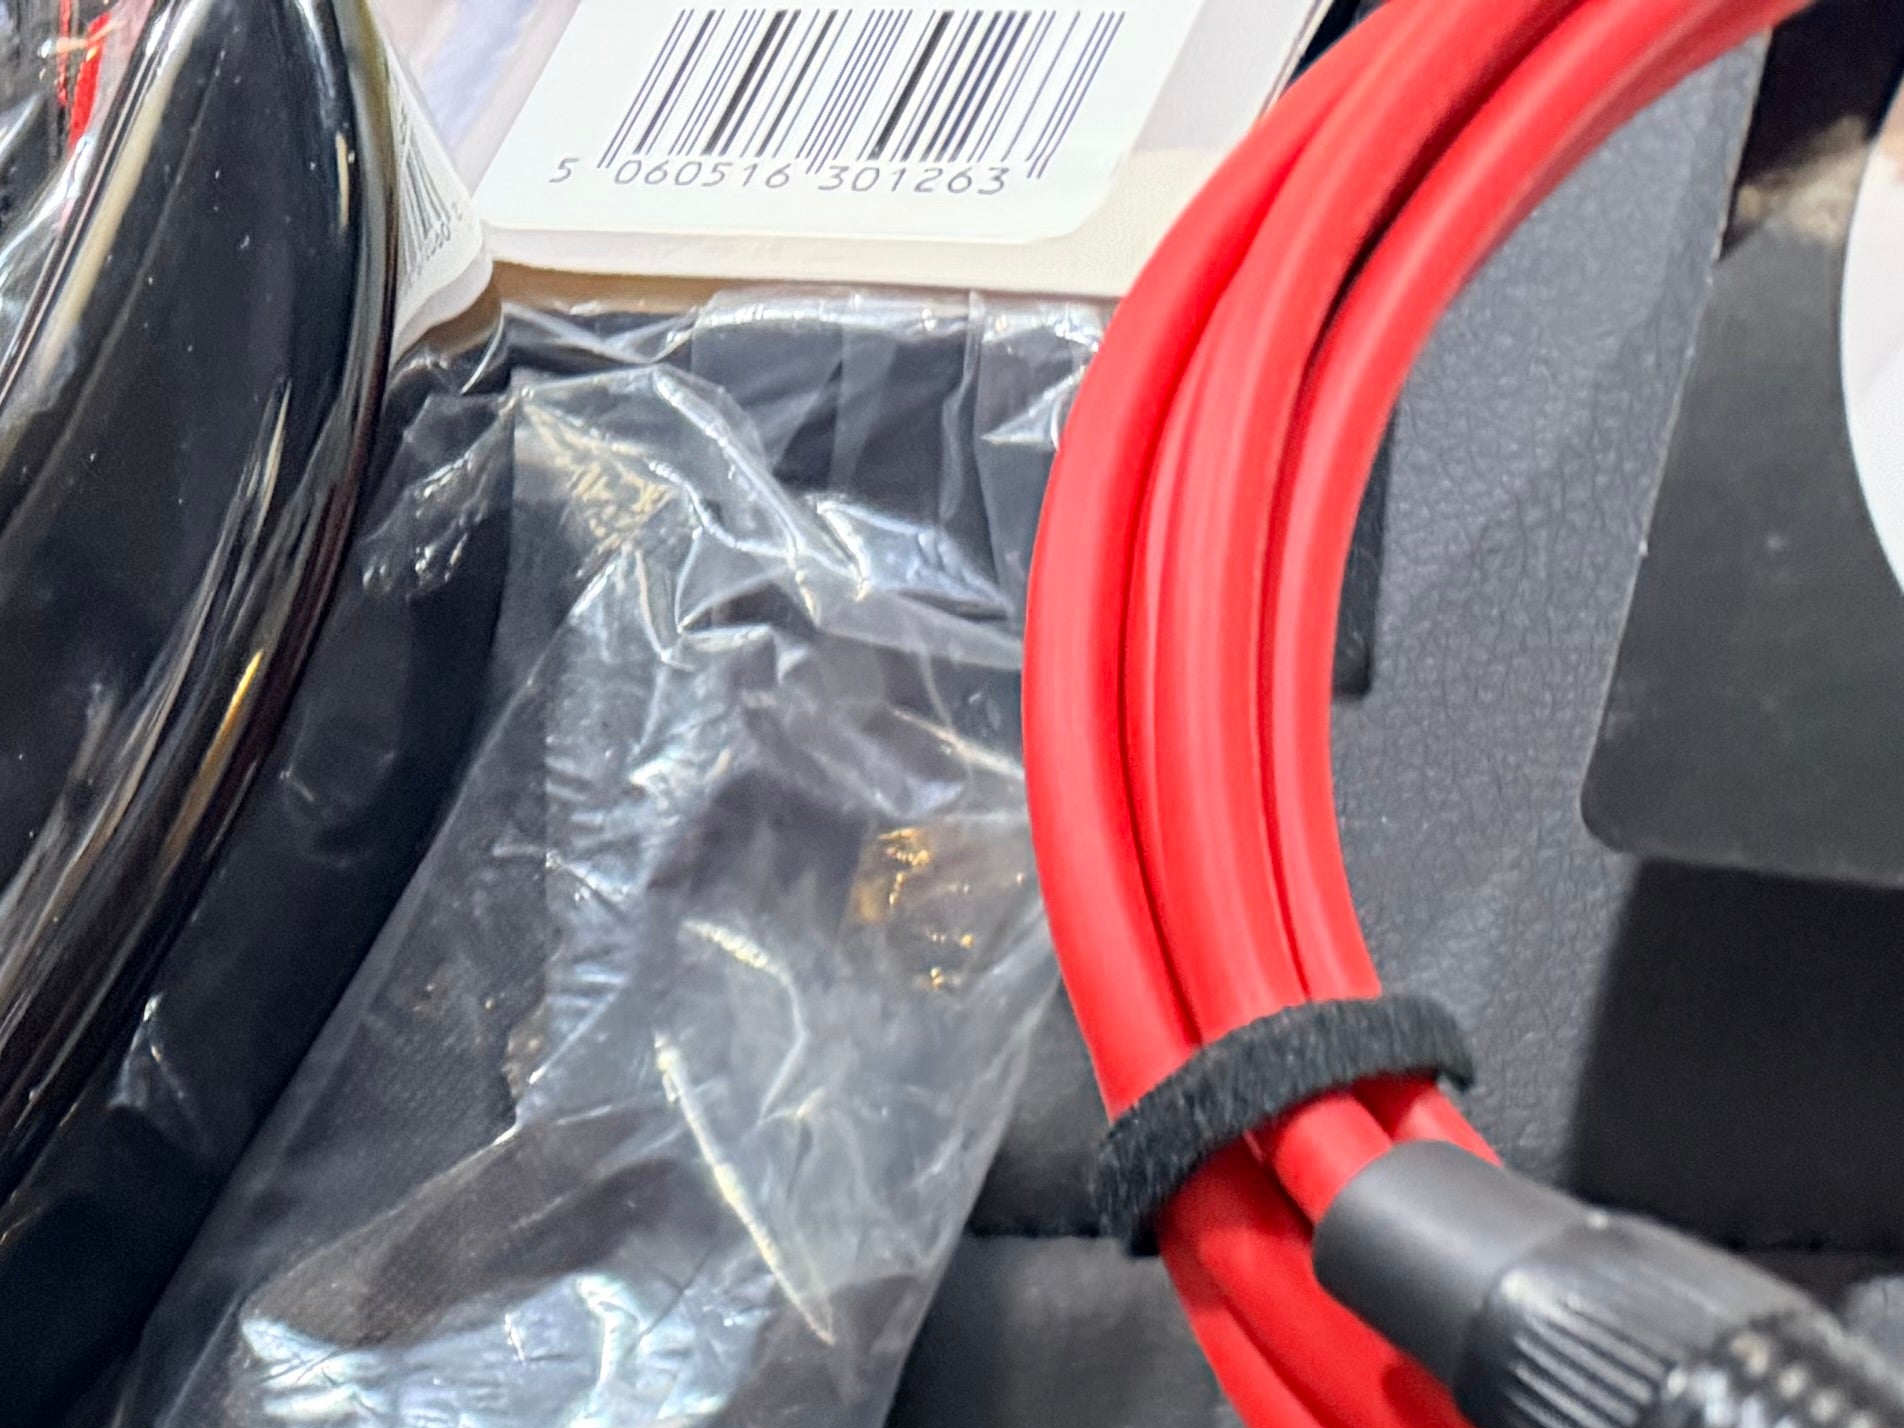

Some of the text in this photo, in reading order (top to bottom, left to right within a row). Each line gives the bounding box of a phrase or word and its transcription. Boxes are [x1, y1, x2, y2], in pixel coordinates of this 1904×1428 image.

[549, 157, 1009, 196] 5 060516 301263
